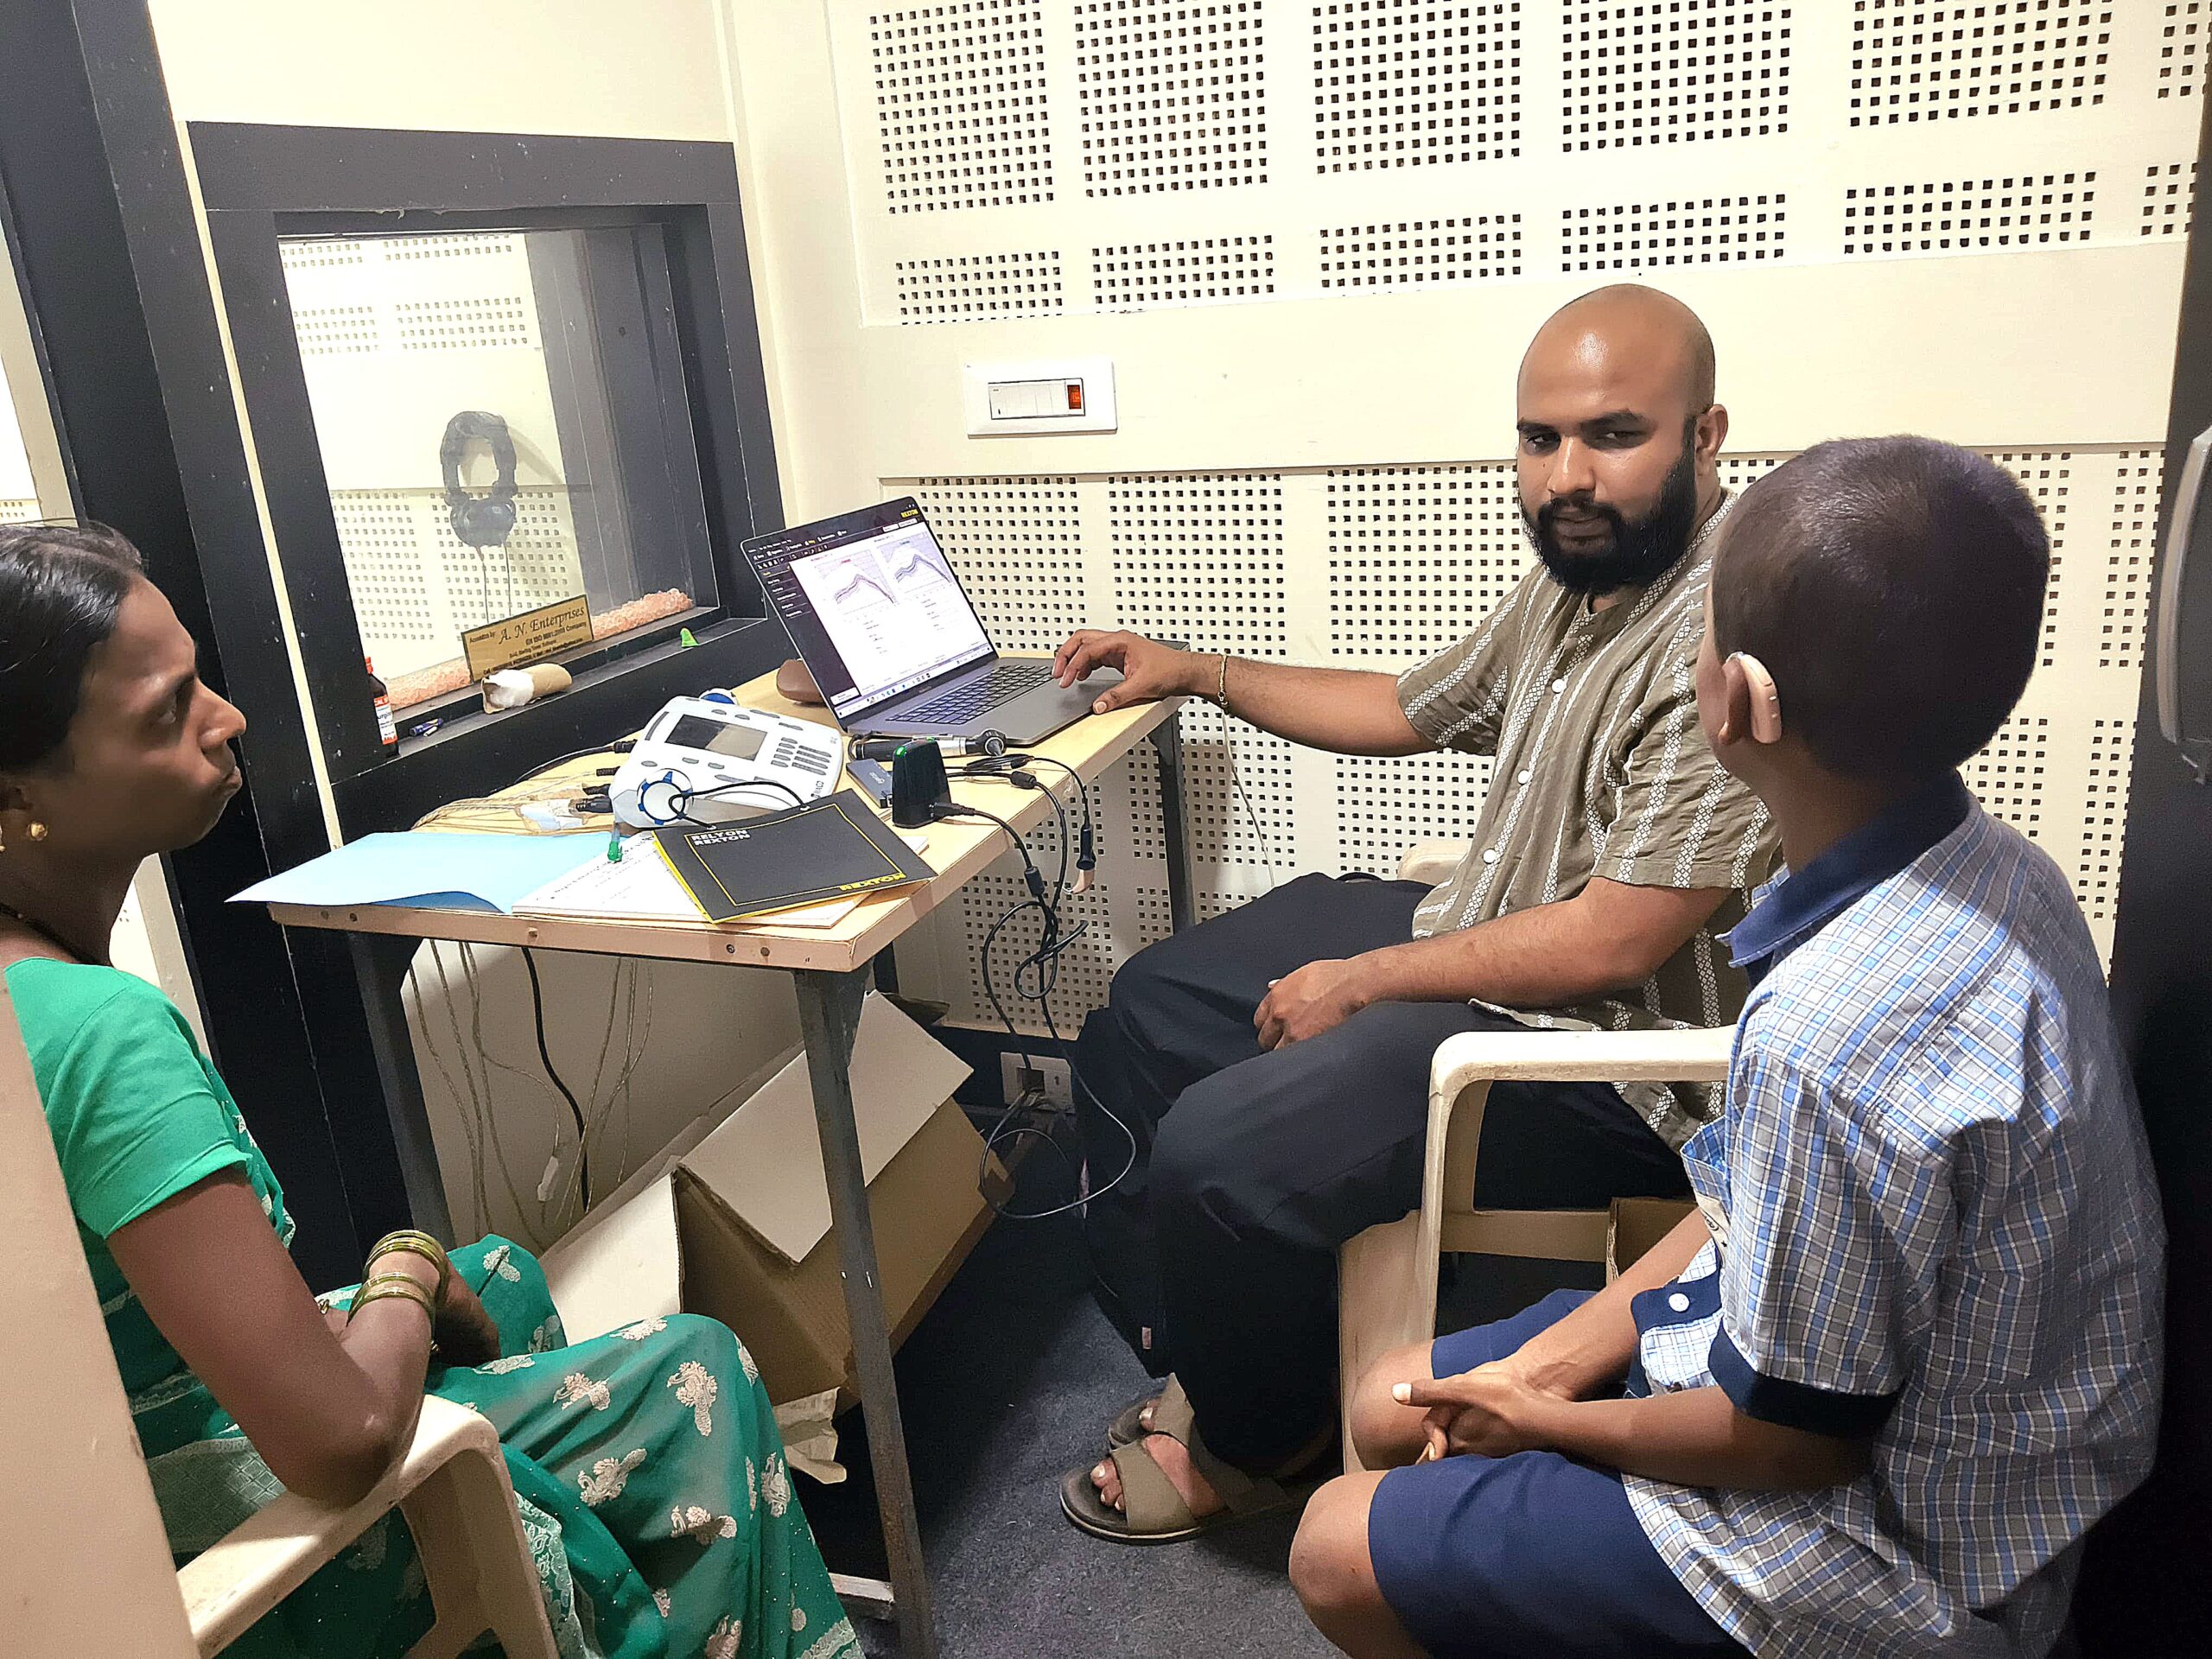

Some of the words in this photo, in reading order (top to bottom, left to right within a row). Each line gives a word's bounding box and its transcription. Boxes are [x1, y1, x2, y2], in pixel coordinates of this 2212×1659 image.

[514, 622, 528, 639] N.
[530, 607, 584, 632] Enterprises
[694, 834, 751, 846] REXTON
[839, 872, 907, 891] REXTON
